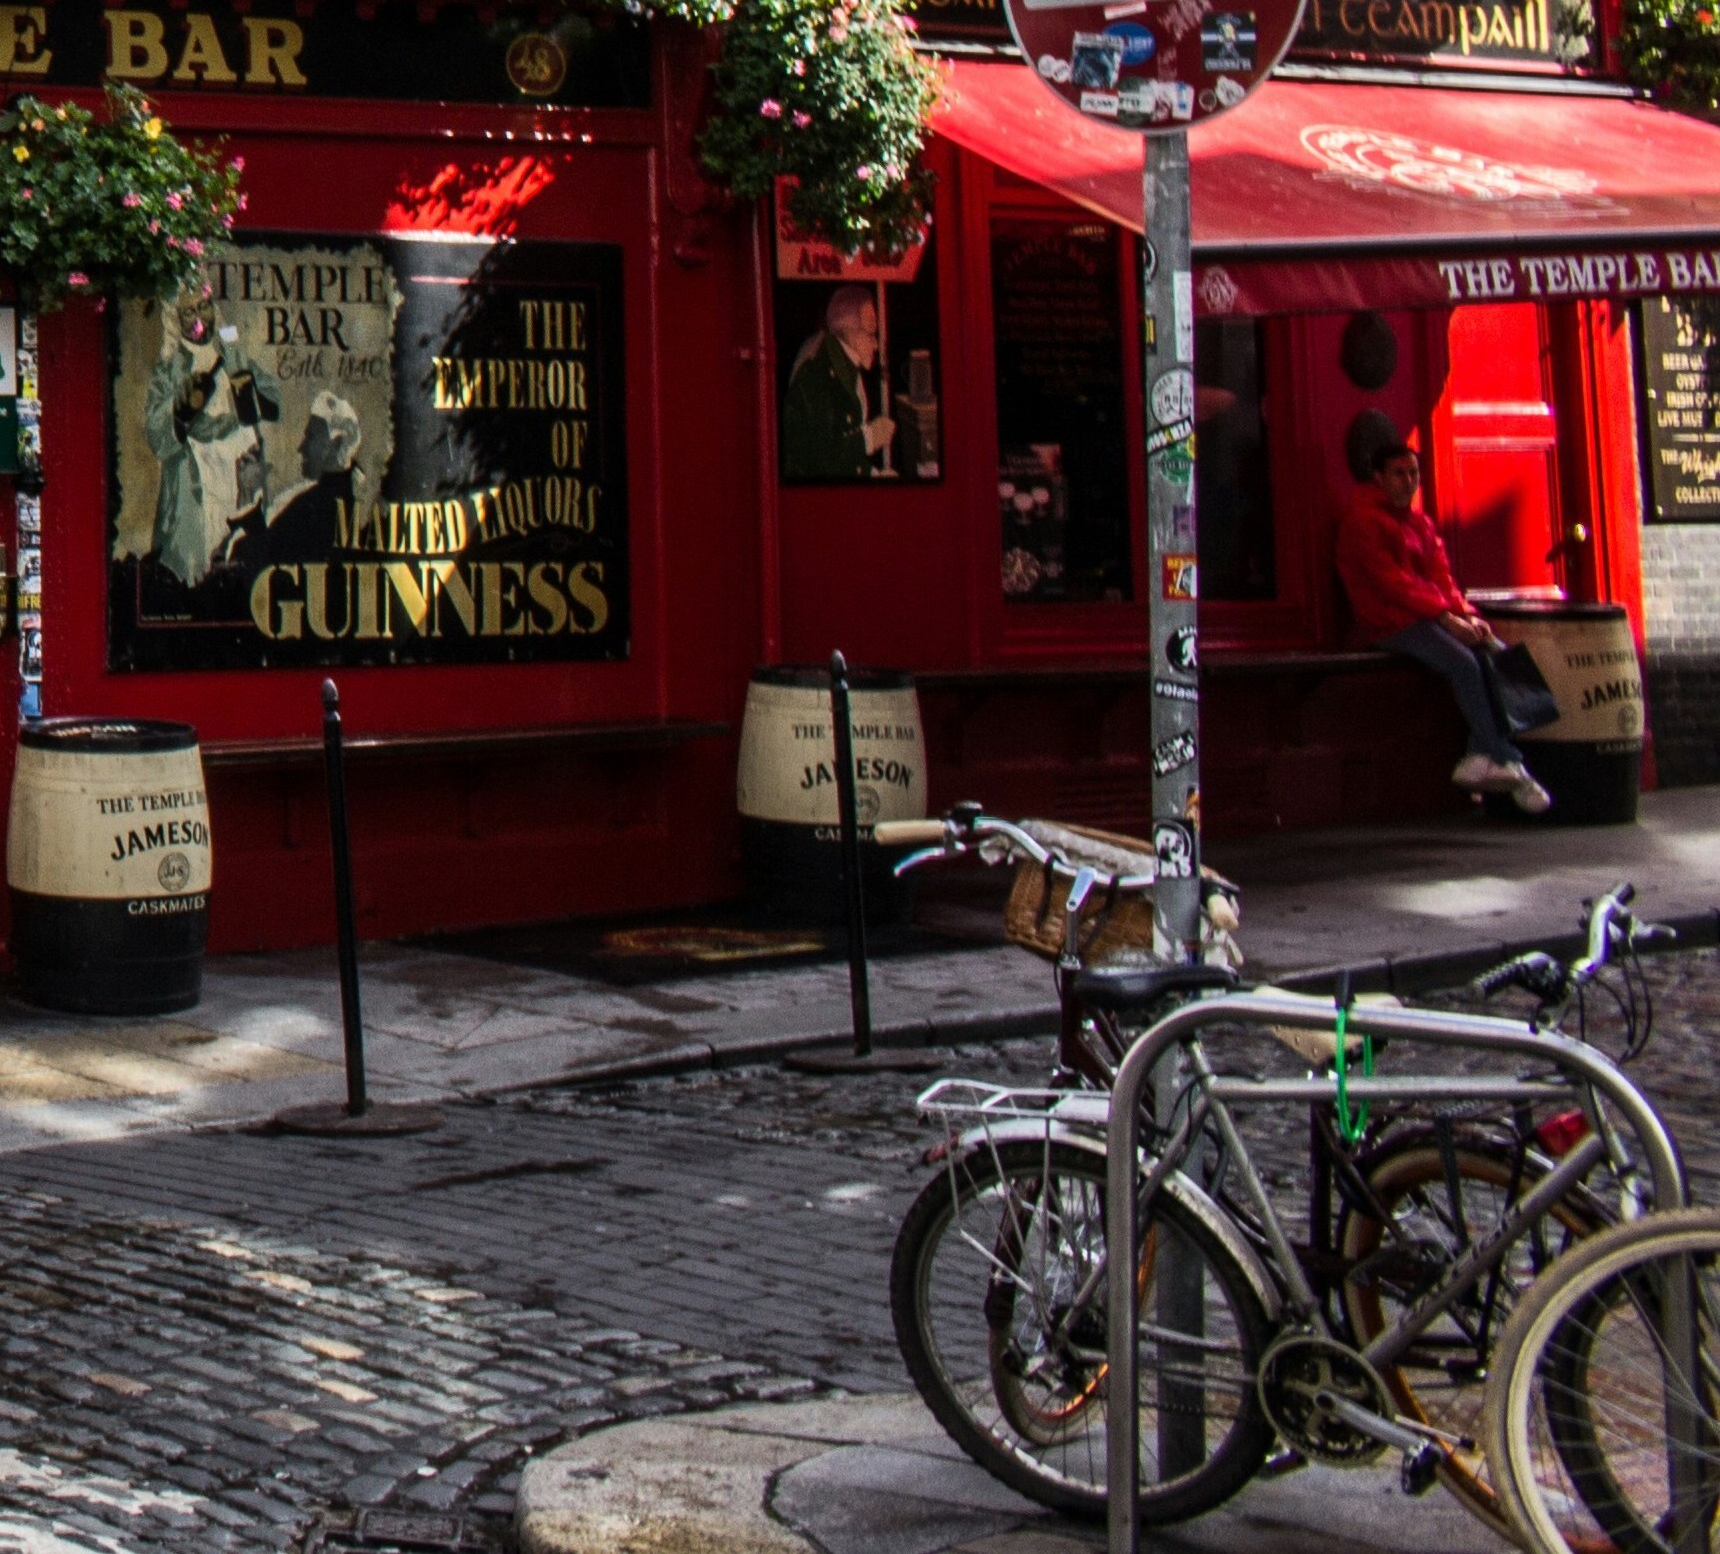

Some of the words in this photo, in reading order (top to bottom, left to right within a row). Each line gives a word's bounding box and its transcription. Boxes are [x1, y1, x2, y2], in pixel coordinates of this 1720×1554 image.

[103, 9, 307, 85] BAR
[209, 262, 387, 303] TEMPLE
[1439, 259, 1515, 298] THE
[1520, 254, 1660, 295] TEMPLE
[263, 307, 349, 351] BAR
[520, 301, 587, 350] THE
[431, 356, 587, 410] EMPEROR
[552, 420, 588, 468] OF
[335, 498, 467, 554] MALTED
[471, 476, 602, 542] LIQUORS
[250, 561, 609, 640] GUINNESS
[792, 724, 825, 739] THE
[800, 758, 913, 790] JAESON
[97, 797, 134, 815] THE
[138, 791, 194, 812] TEMPLE
[110, 820, 209, 862] JAMESON
[127, 895, 206, 916] CASKMATES
